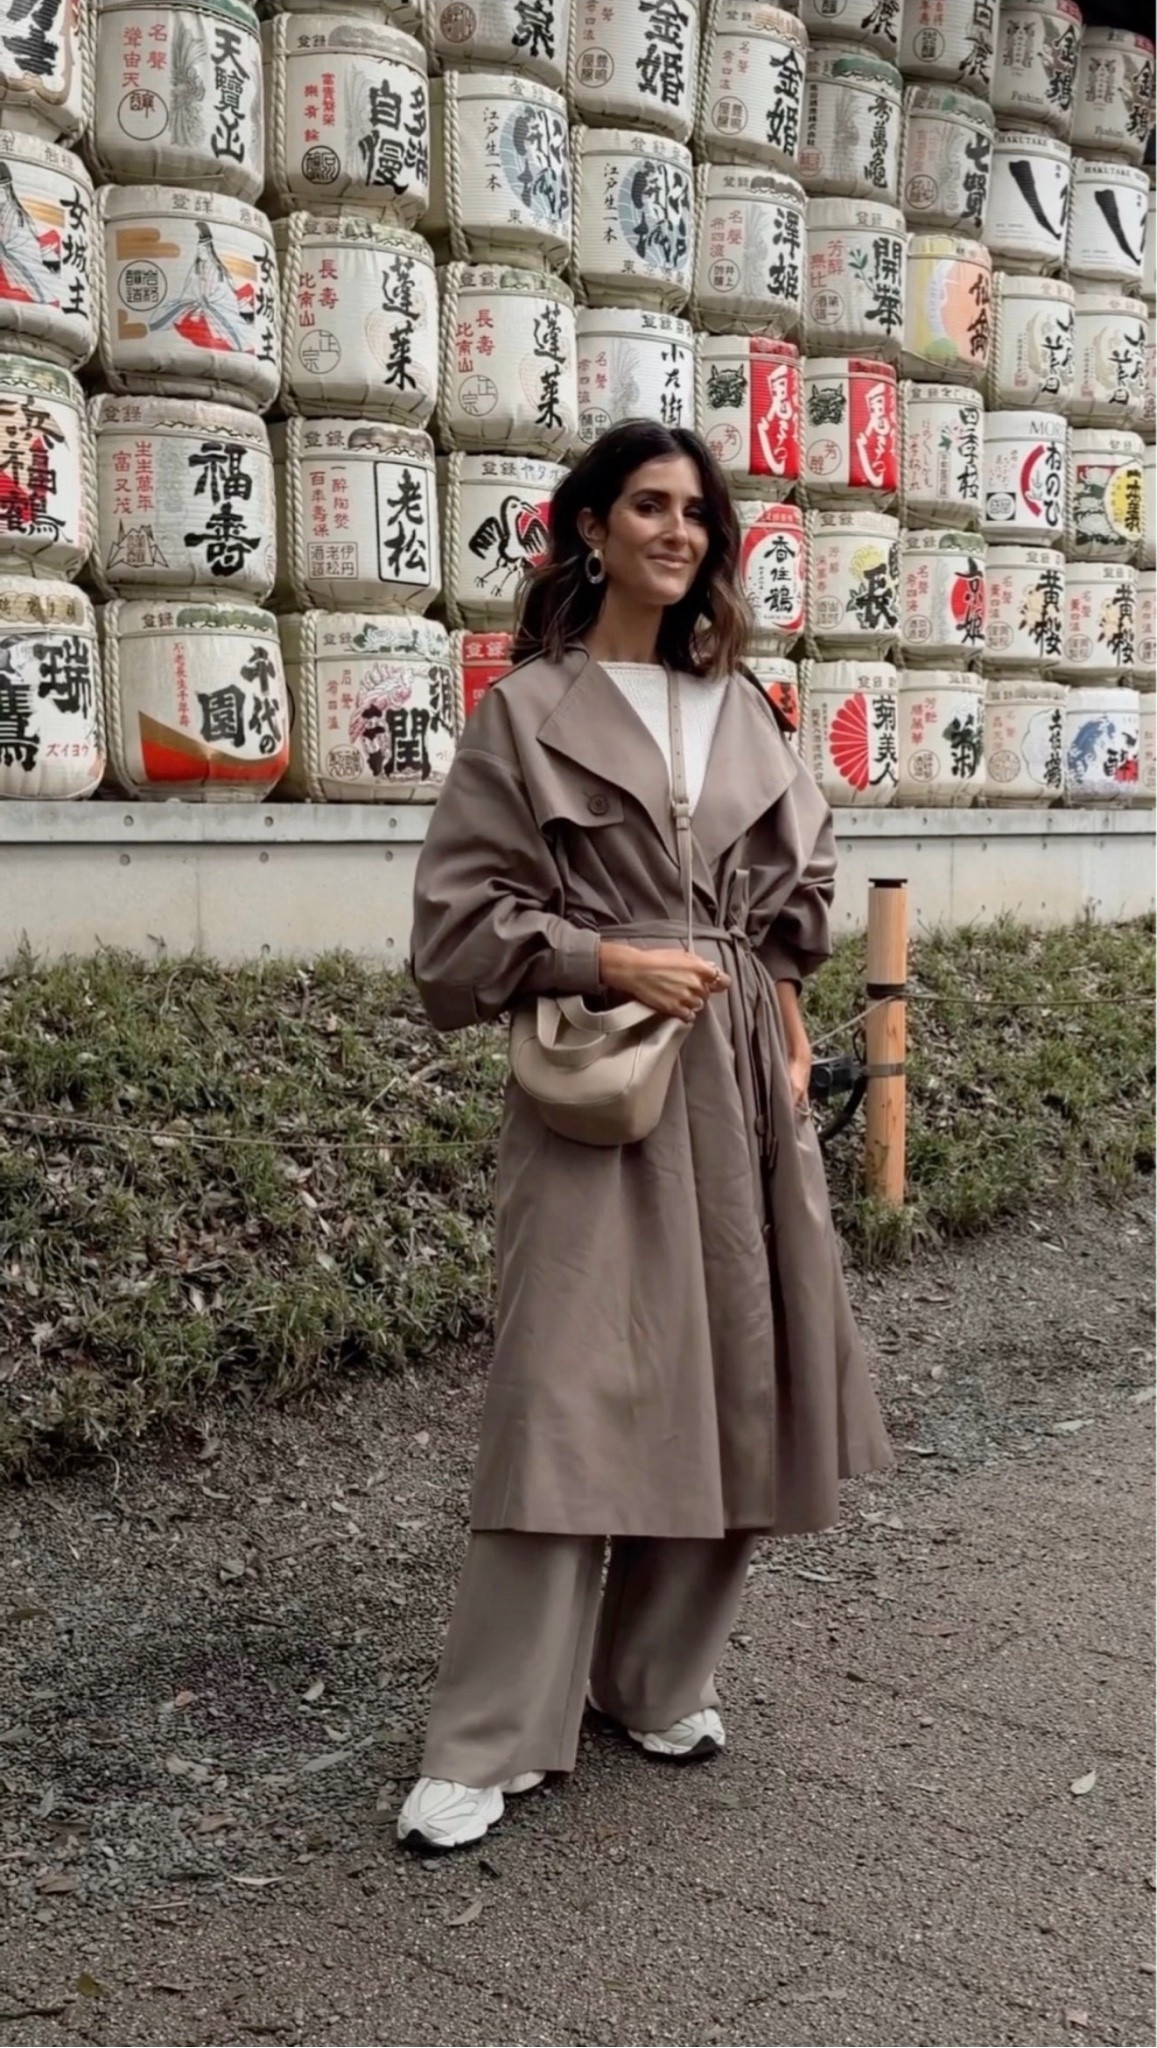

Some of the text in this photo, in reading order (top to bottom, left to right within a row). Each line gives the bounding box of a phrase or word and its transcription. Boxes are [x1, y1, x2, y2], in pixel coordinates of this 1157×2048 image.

[483, 108, 501, 191] 江戸生一本
[603, 163, 619, 244] 江戸生一本
[59, 186, 90, 320] 女城主
[318, 259, 339, 310] 長壽
[253, 242, 275, 363] 女城主
[297, 273, 316, 327] 比南山
[475, 309, 495, 356] 長壽
[456, 323, 474, 374] 比南山
[383, 467, 428, 578] 老松
[1044, 441, 1062, 527] ねのひ
[764, 535, 797, 613] 香住鶴
[868, 695, 898, 788] 菊美人
